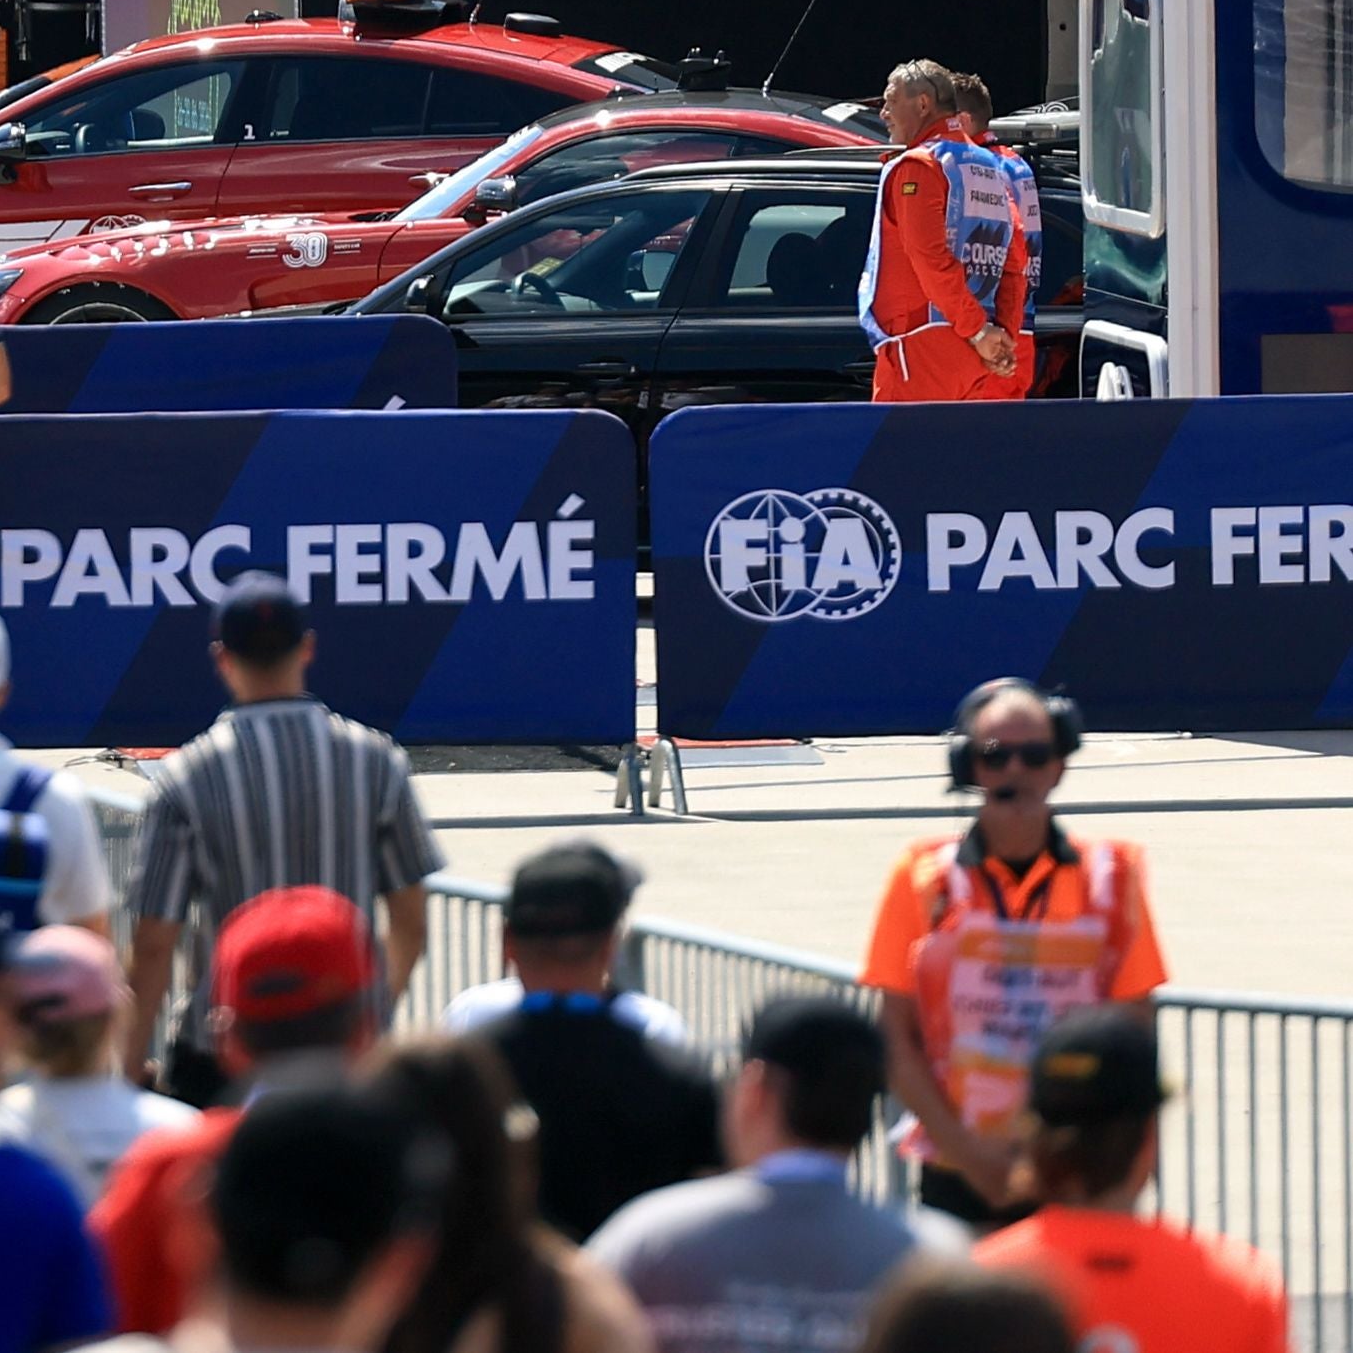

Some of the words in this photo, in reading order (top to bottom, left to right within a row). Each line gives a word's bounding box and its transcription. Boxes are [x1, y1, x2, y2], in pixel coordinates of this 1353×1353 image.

[244, 124, 255, 140] 1
[282, 231, 328, 268] 30
[0, 523, 252, 608] PARC
[288, 493, 596, 605] FERMÉ
[926, 507, 1175, 591] PARC
